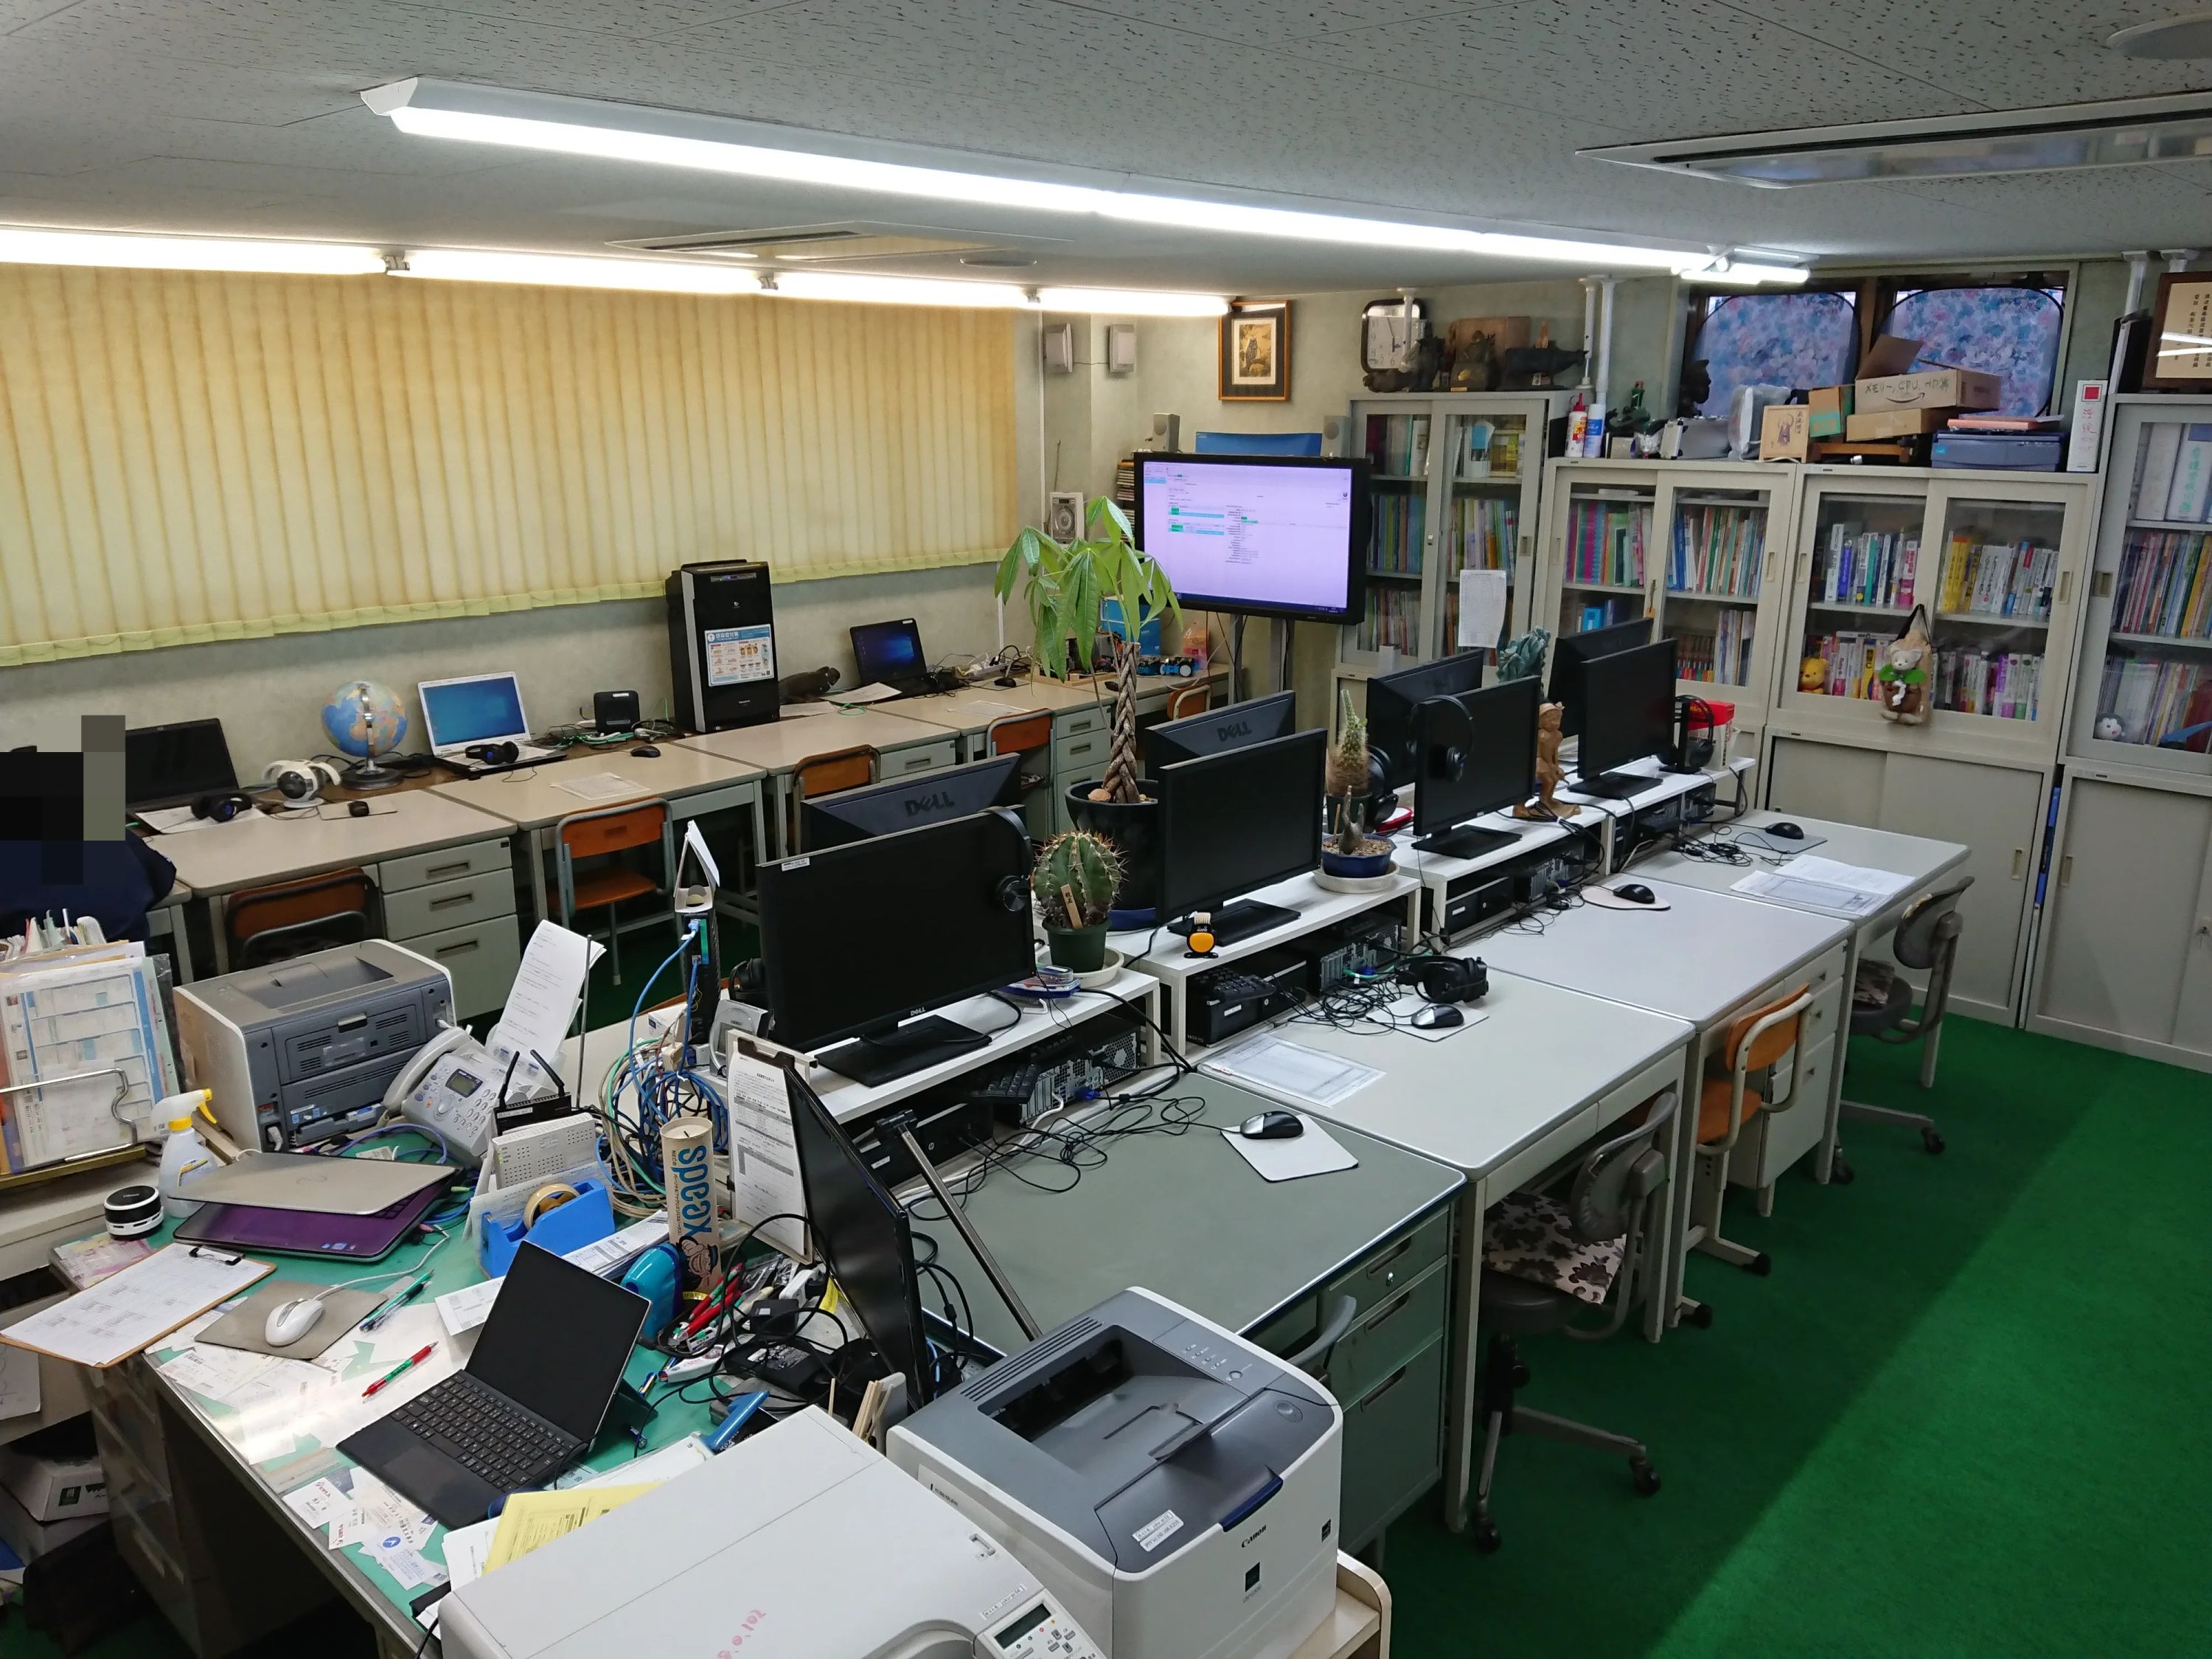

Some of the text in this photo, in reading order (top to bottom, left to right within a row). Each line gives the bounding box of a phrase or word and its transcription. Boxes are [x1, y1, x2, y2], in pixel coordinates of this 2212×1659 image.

[1217, 721, 1252, 742] DELL
[904, 791, 955, 817] DELL
[910, 1006, 926, 1016] DELL
[672, 1144, 712, 1238] speax
[1241, 1524, 1267, 1548] Canon
